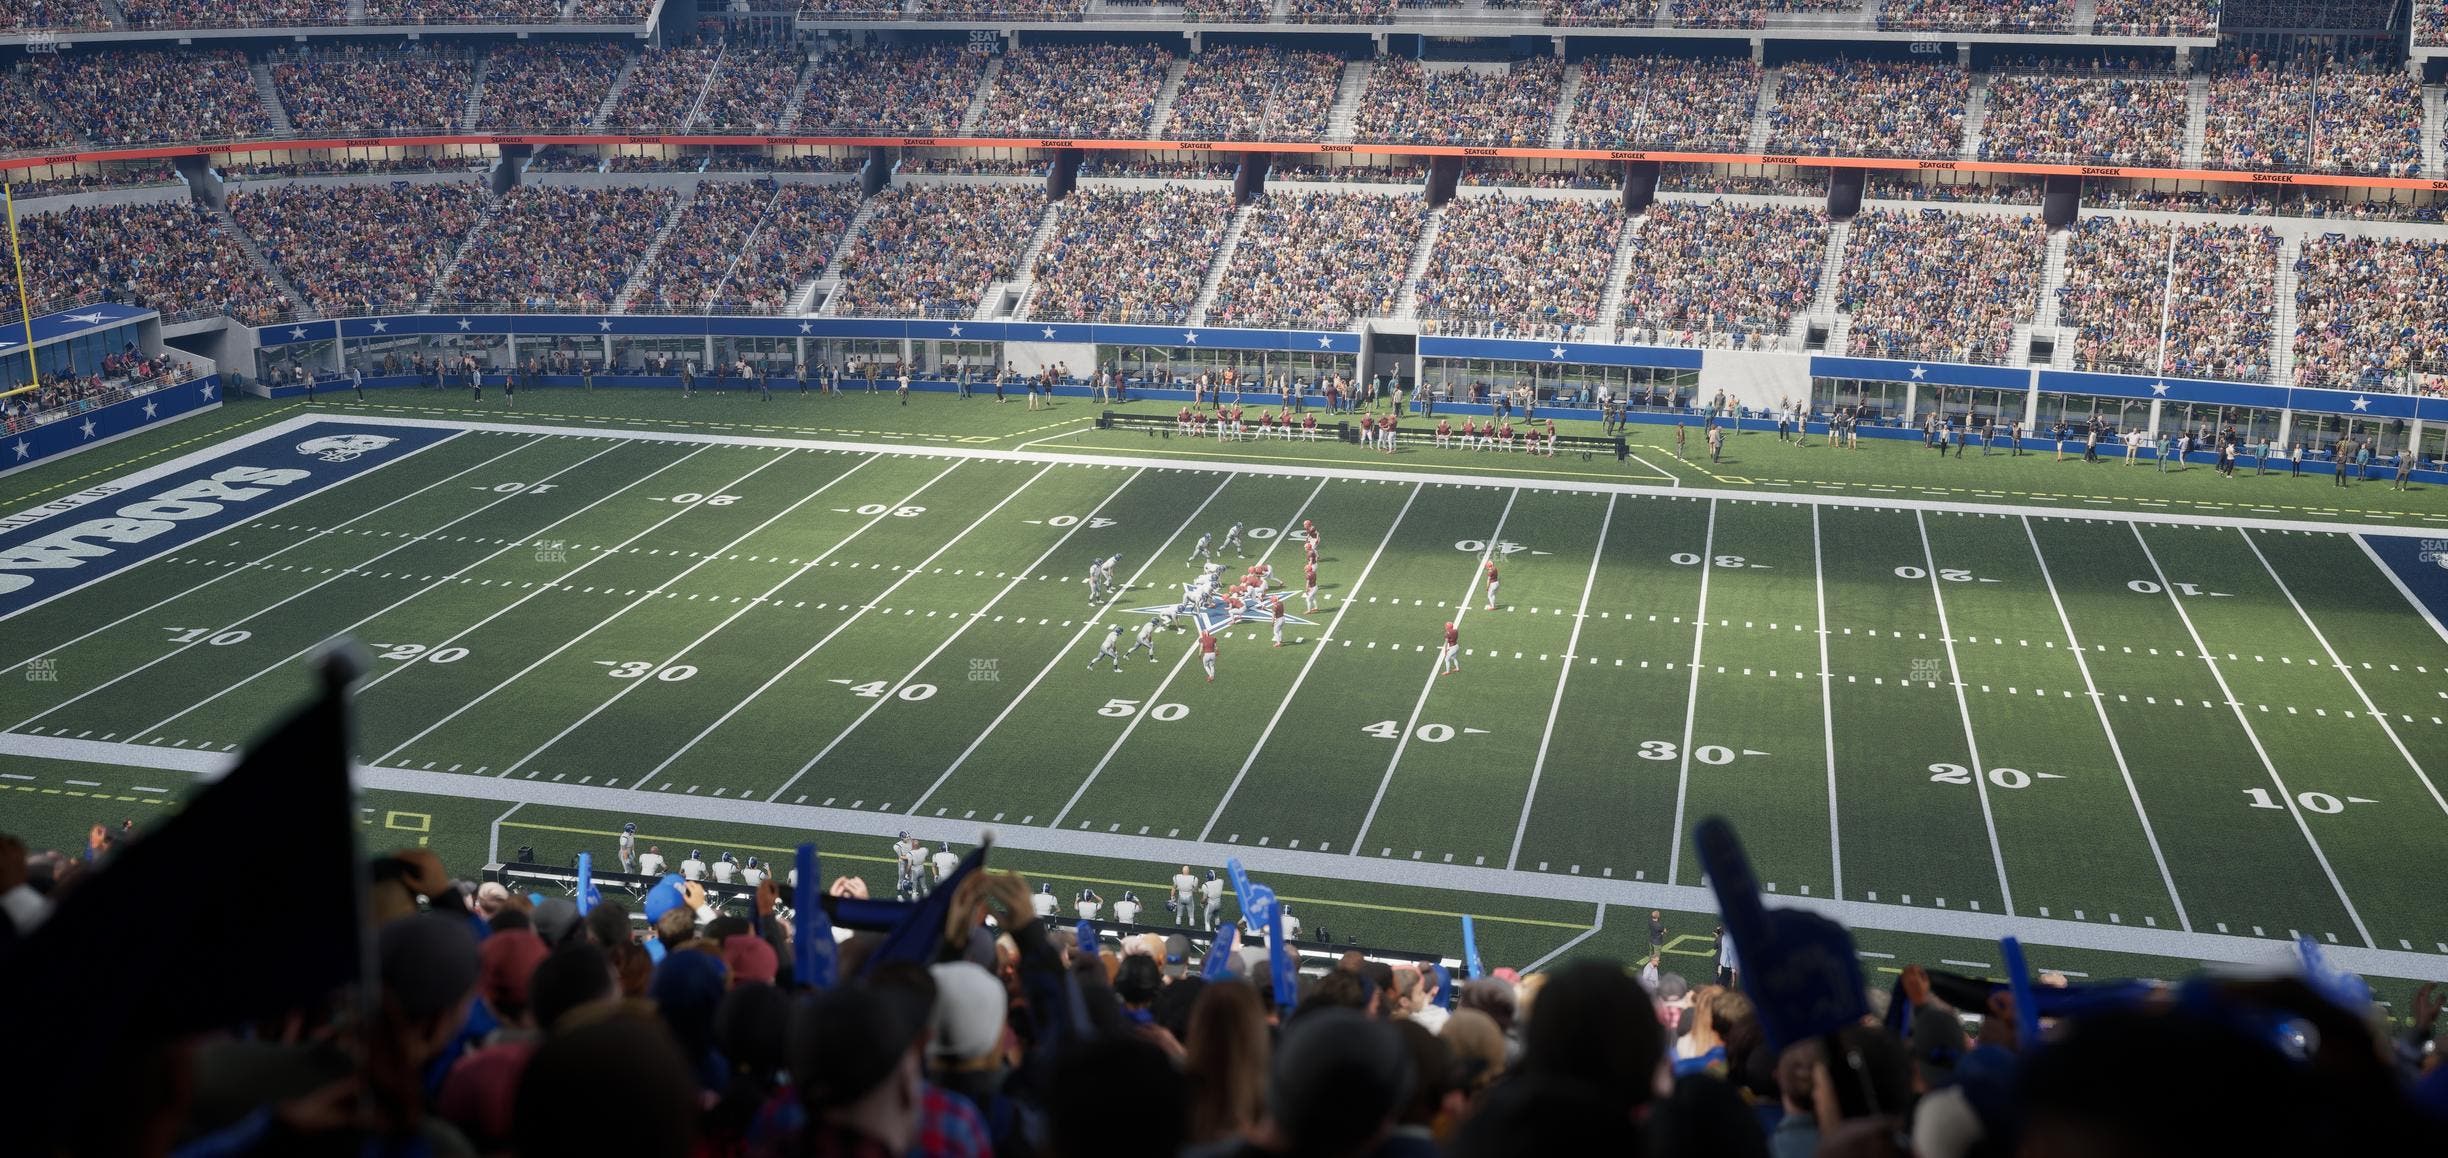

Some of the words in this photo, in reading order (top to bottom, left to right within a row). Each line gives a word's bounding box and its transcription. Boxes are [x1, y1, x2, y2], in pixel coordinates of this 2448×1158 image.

[197, 145, 231, 154] SEATGEEK
[346, 139, 380, 147] SEATGEEK
[45, 155, 78, 164] SEATGEEK
[1763, 156, 1797, 164] SEATGEEK
[1919, 161, 1955, 169] SEATGEEK
[2082, 167, 2120, 175] SEATGEEK
[2253, 174, 2292, 182] SEATGEEK
[0, 513, 50, 529] ALL
[43, 499, 82, 510] OF
[78, 486, 122, 497] US
[0, 466, 311, 594] WBOYS
[167, 628, 252, 646] 10
[380, 644, 469, 663] 20
[608, 661, 698, 682] 30
[850, 680, 938, 701] 40
[1097, 699, 1190, 721] 50
[1361, 720, 1456, 743] 40
[1637, 740, 1735, 765] 30
[1928, 763, 2031, 789] 20
[2242, 788, 2345, 814] 10
